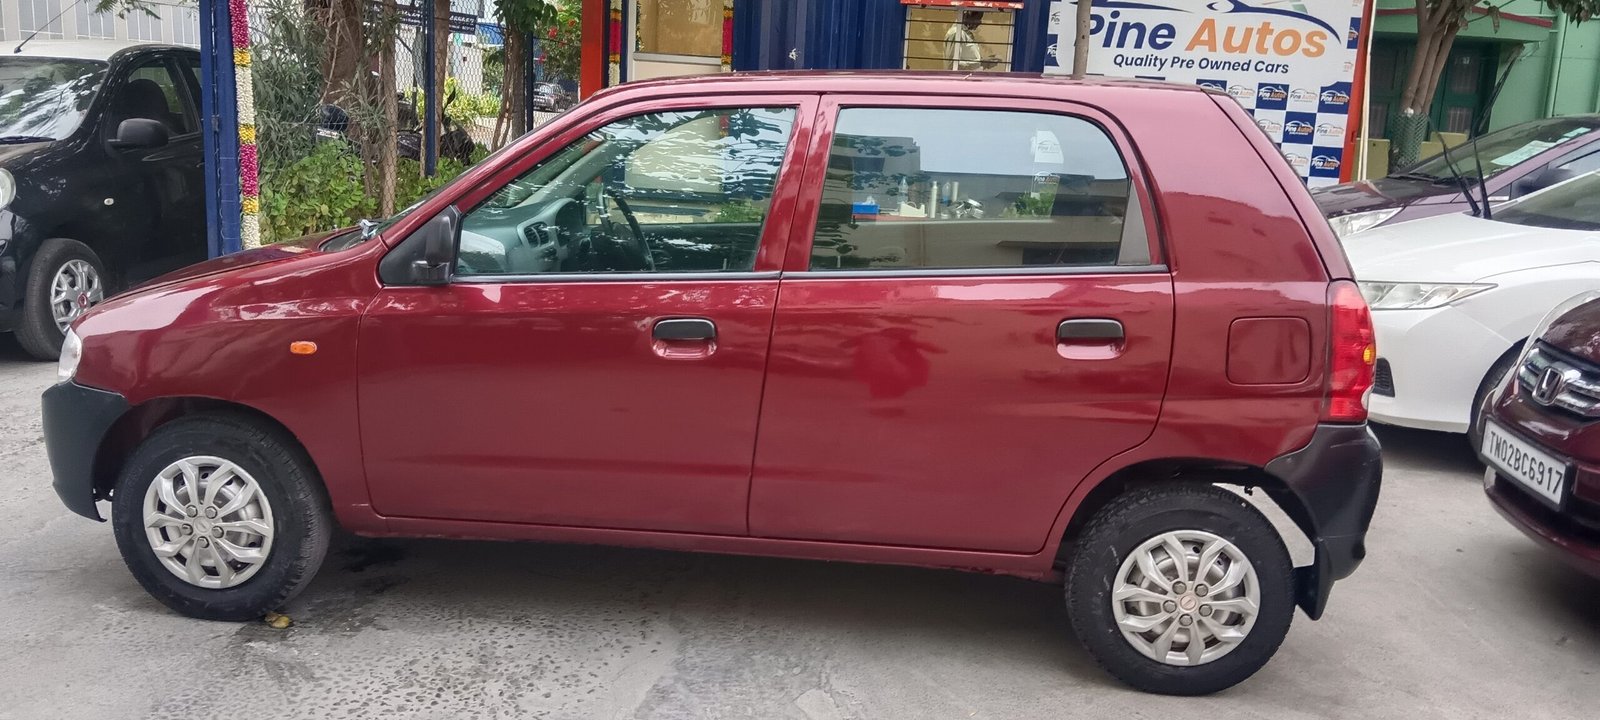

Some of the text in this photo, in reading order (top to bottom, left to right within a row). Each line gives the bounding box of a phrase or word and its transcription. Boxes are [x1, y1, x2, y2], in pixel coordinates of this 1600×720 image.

[1184, 18, 1328, 58] Autos
[1113, 54, 1290, 74] Quality Pre Owned Cars
[1490, 430, 1563, 495] TN02BC6917
